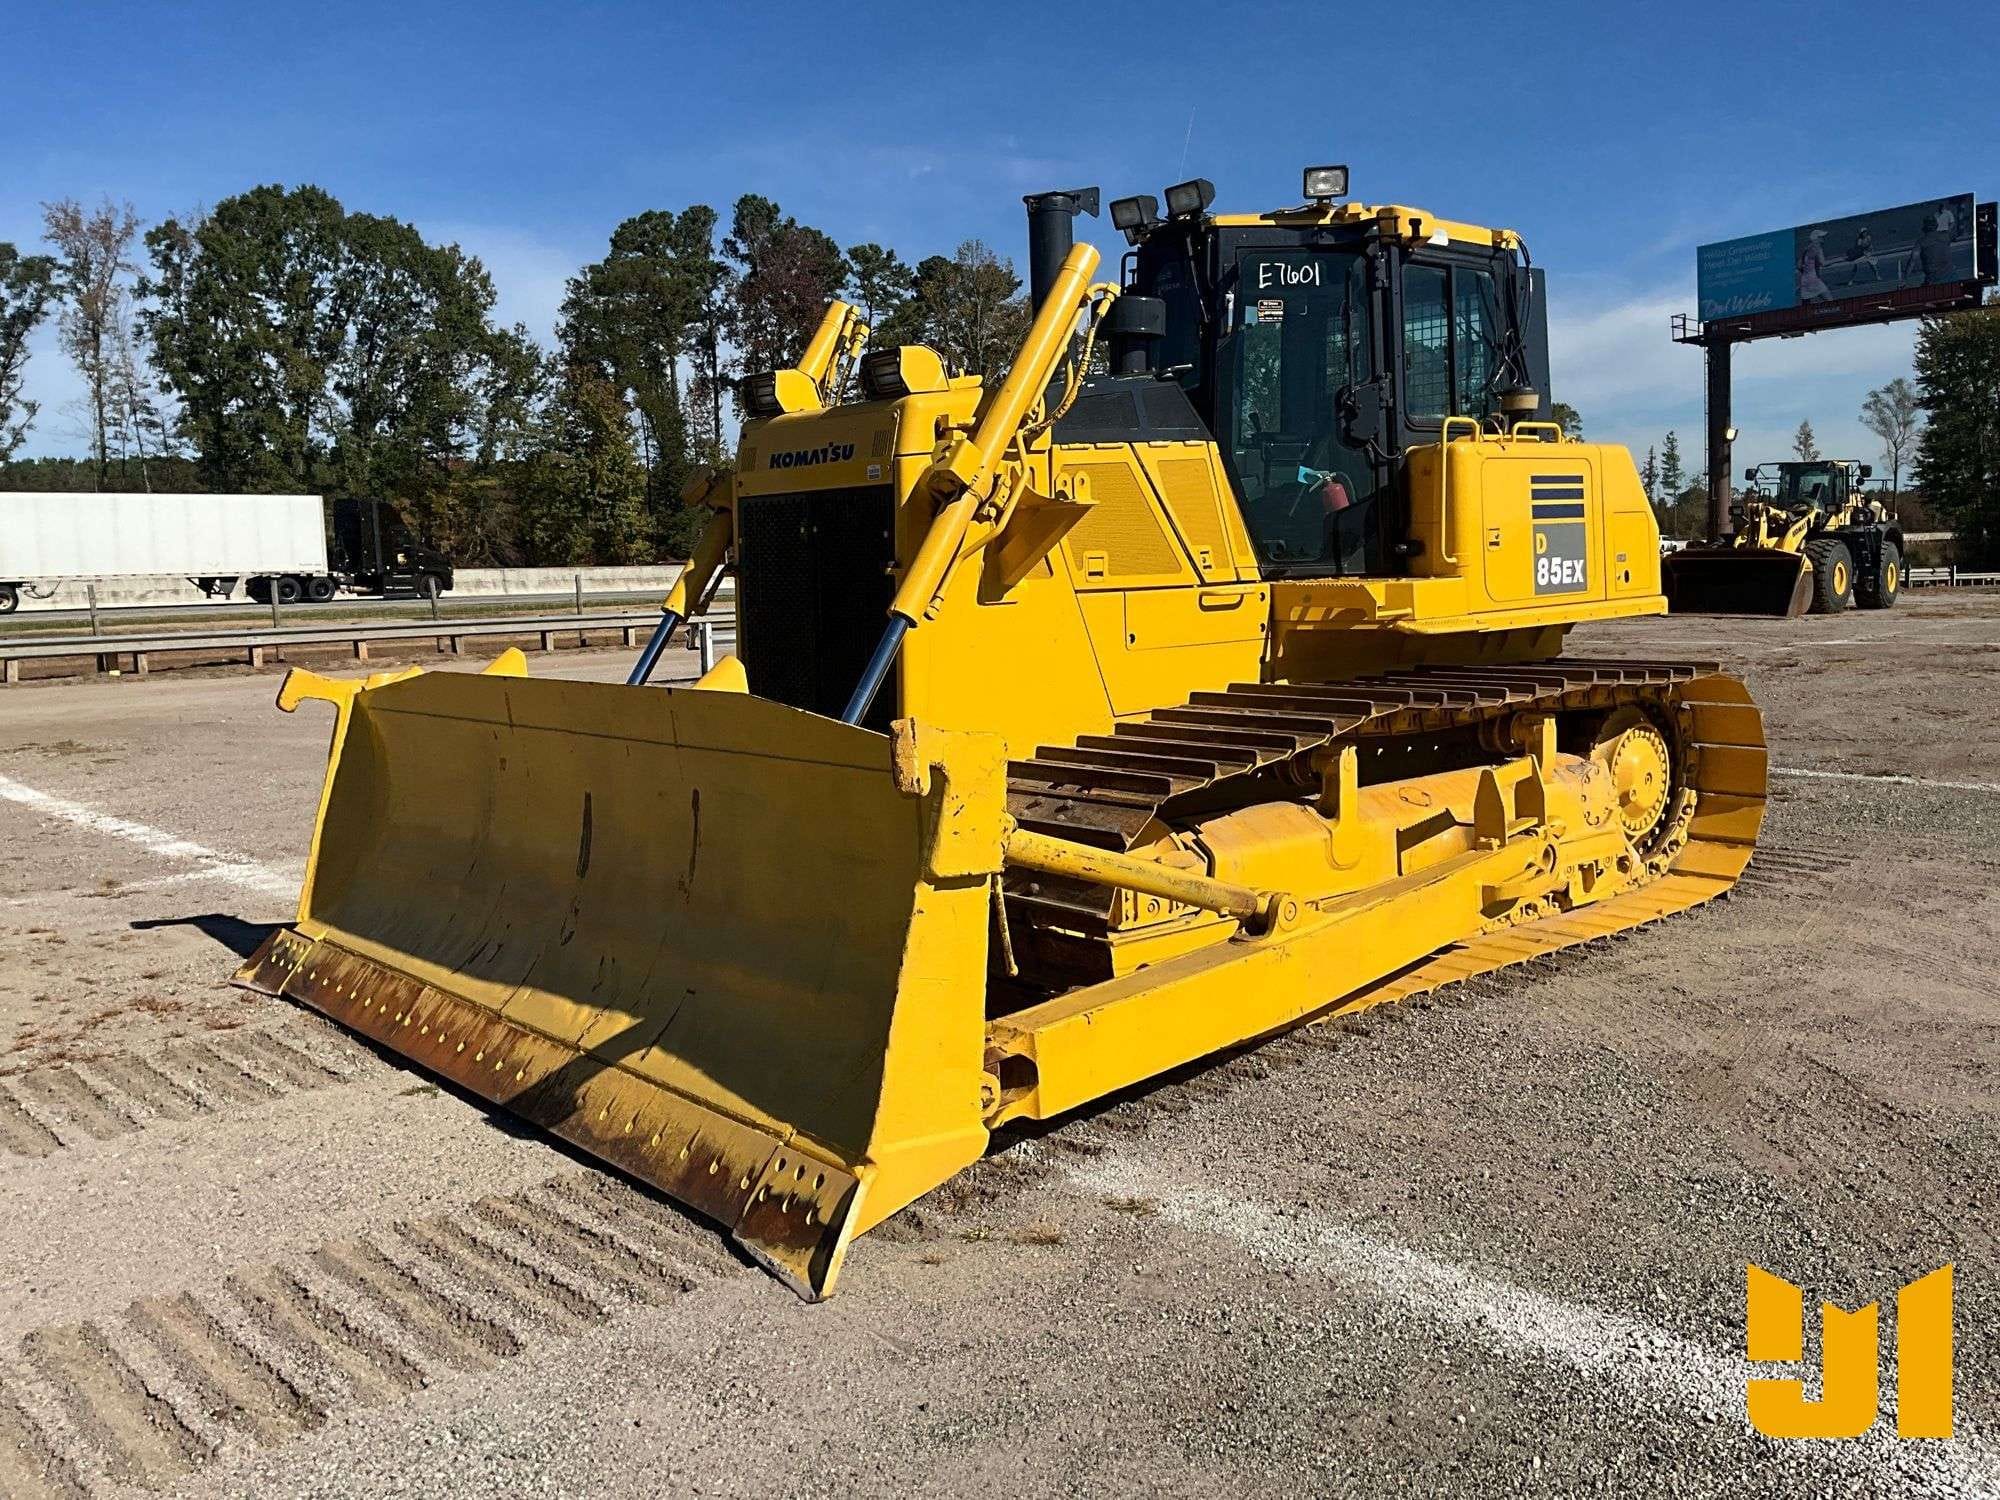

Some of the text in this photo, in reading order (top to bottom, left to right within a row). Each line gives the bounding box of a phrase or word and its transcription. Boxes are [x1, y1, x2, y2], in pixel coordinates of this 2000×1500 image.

[1258, 261, 1320, 289] E7601
[769, 442, 855, 469] KOMATSU
[1535, 532, 1547, 554] D
[1537, 557, 1584, 586] 85EX
